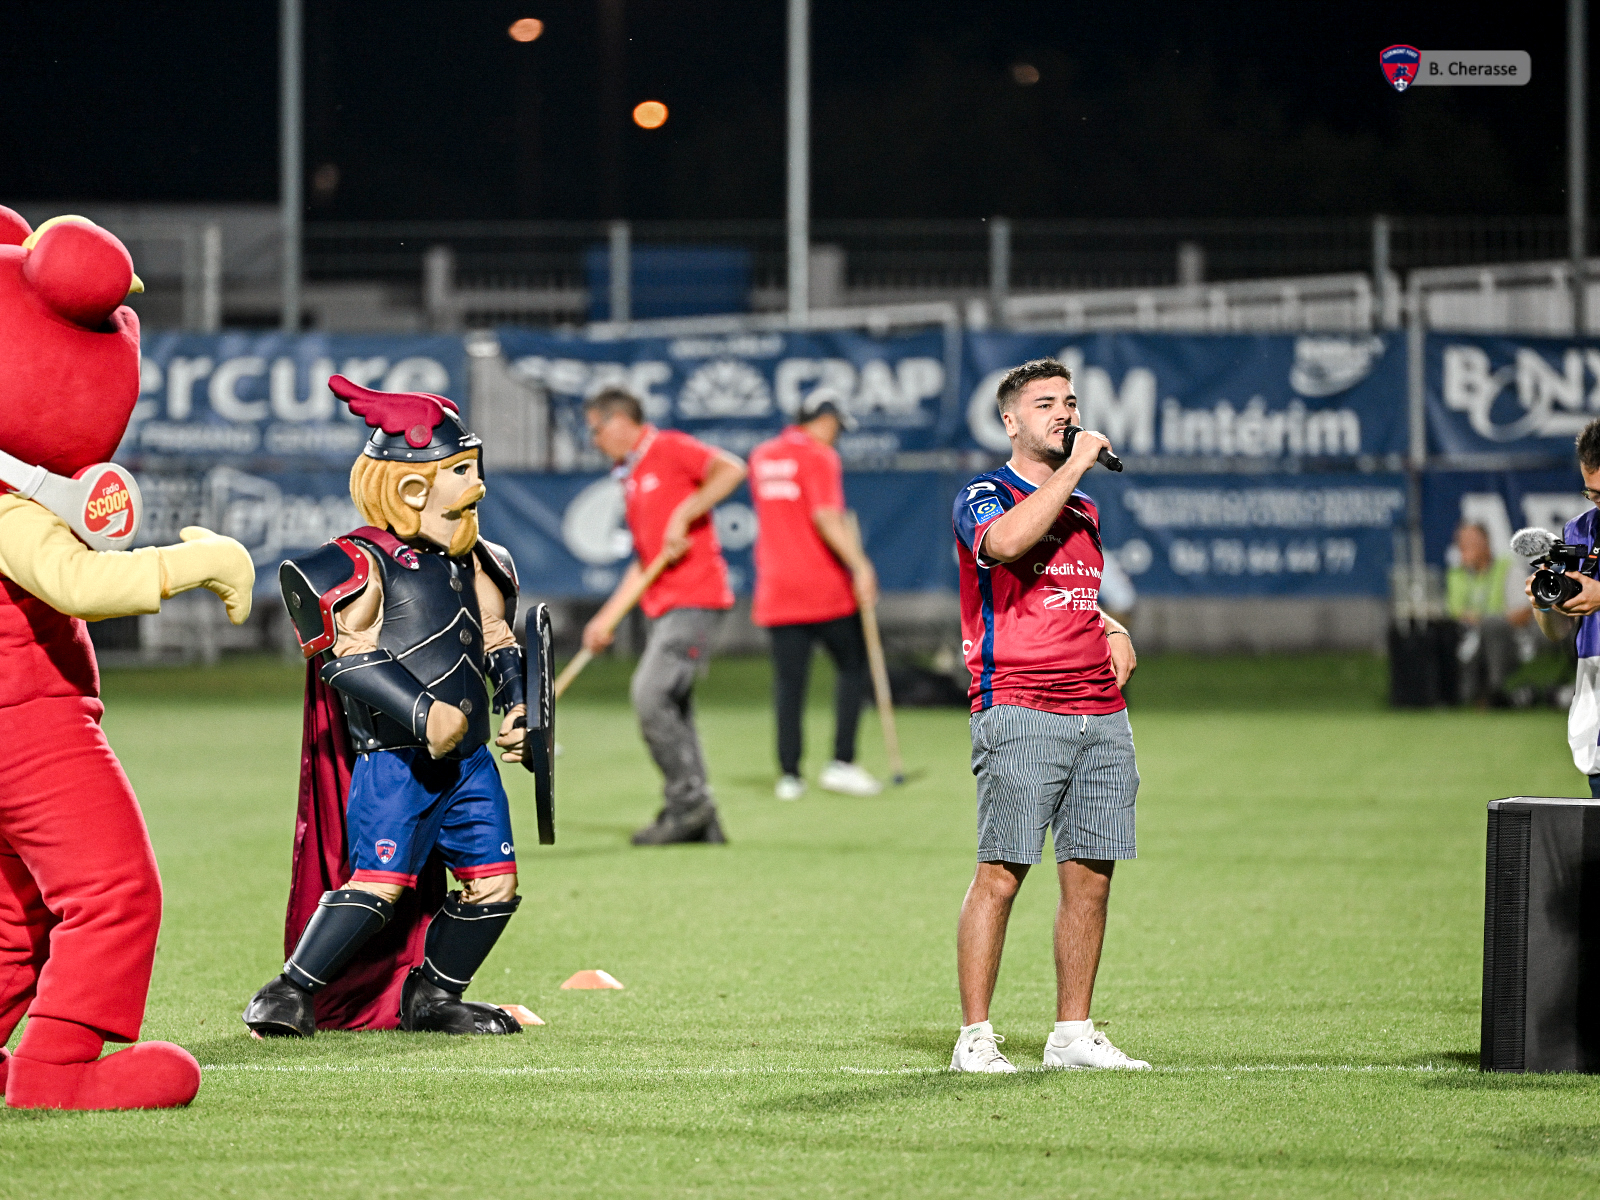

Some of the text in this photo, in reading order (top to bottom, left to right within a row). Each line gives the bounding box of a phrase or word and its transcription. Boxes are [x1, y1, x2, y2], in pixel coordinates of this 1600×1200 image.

[102, 482, 120, 496] radio
[87, 489, 129, 519] SCOOP
[1033, 562, 1075, 576] Crédit
